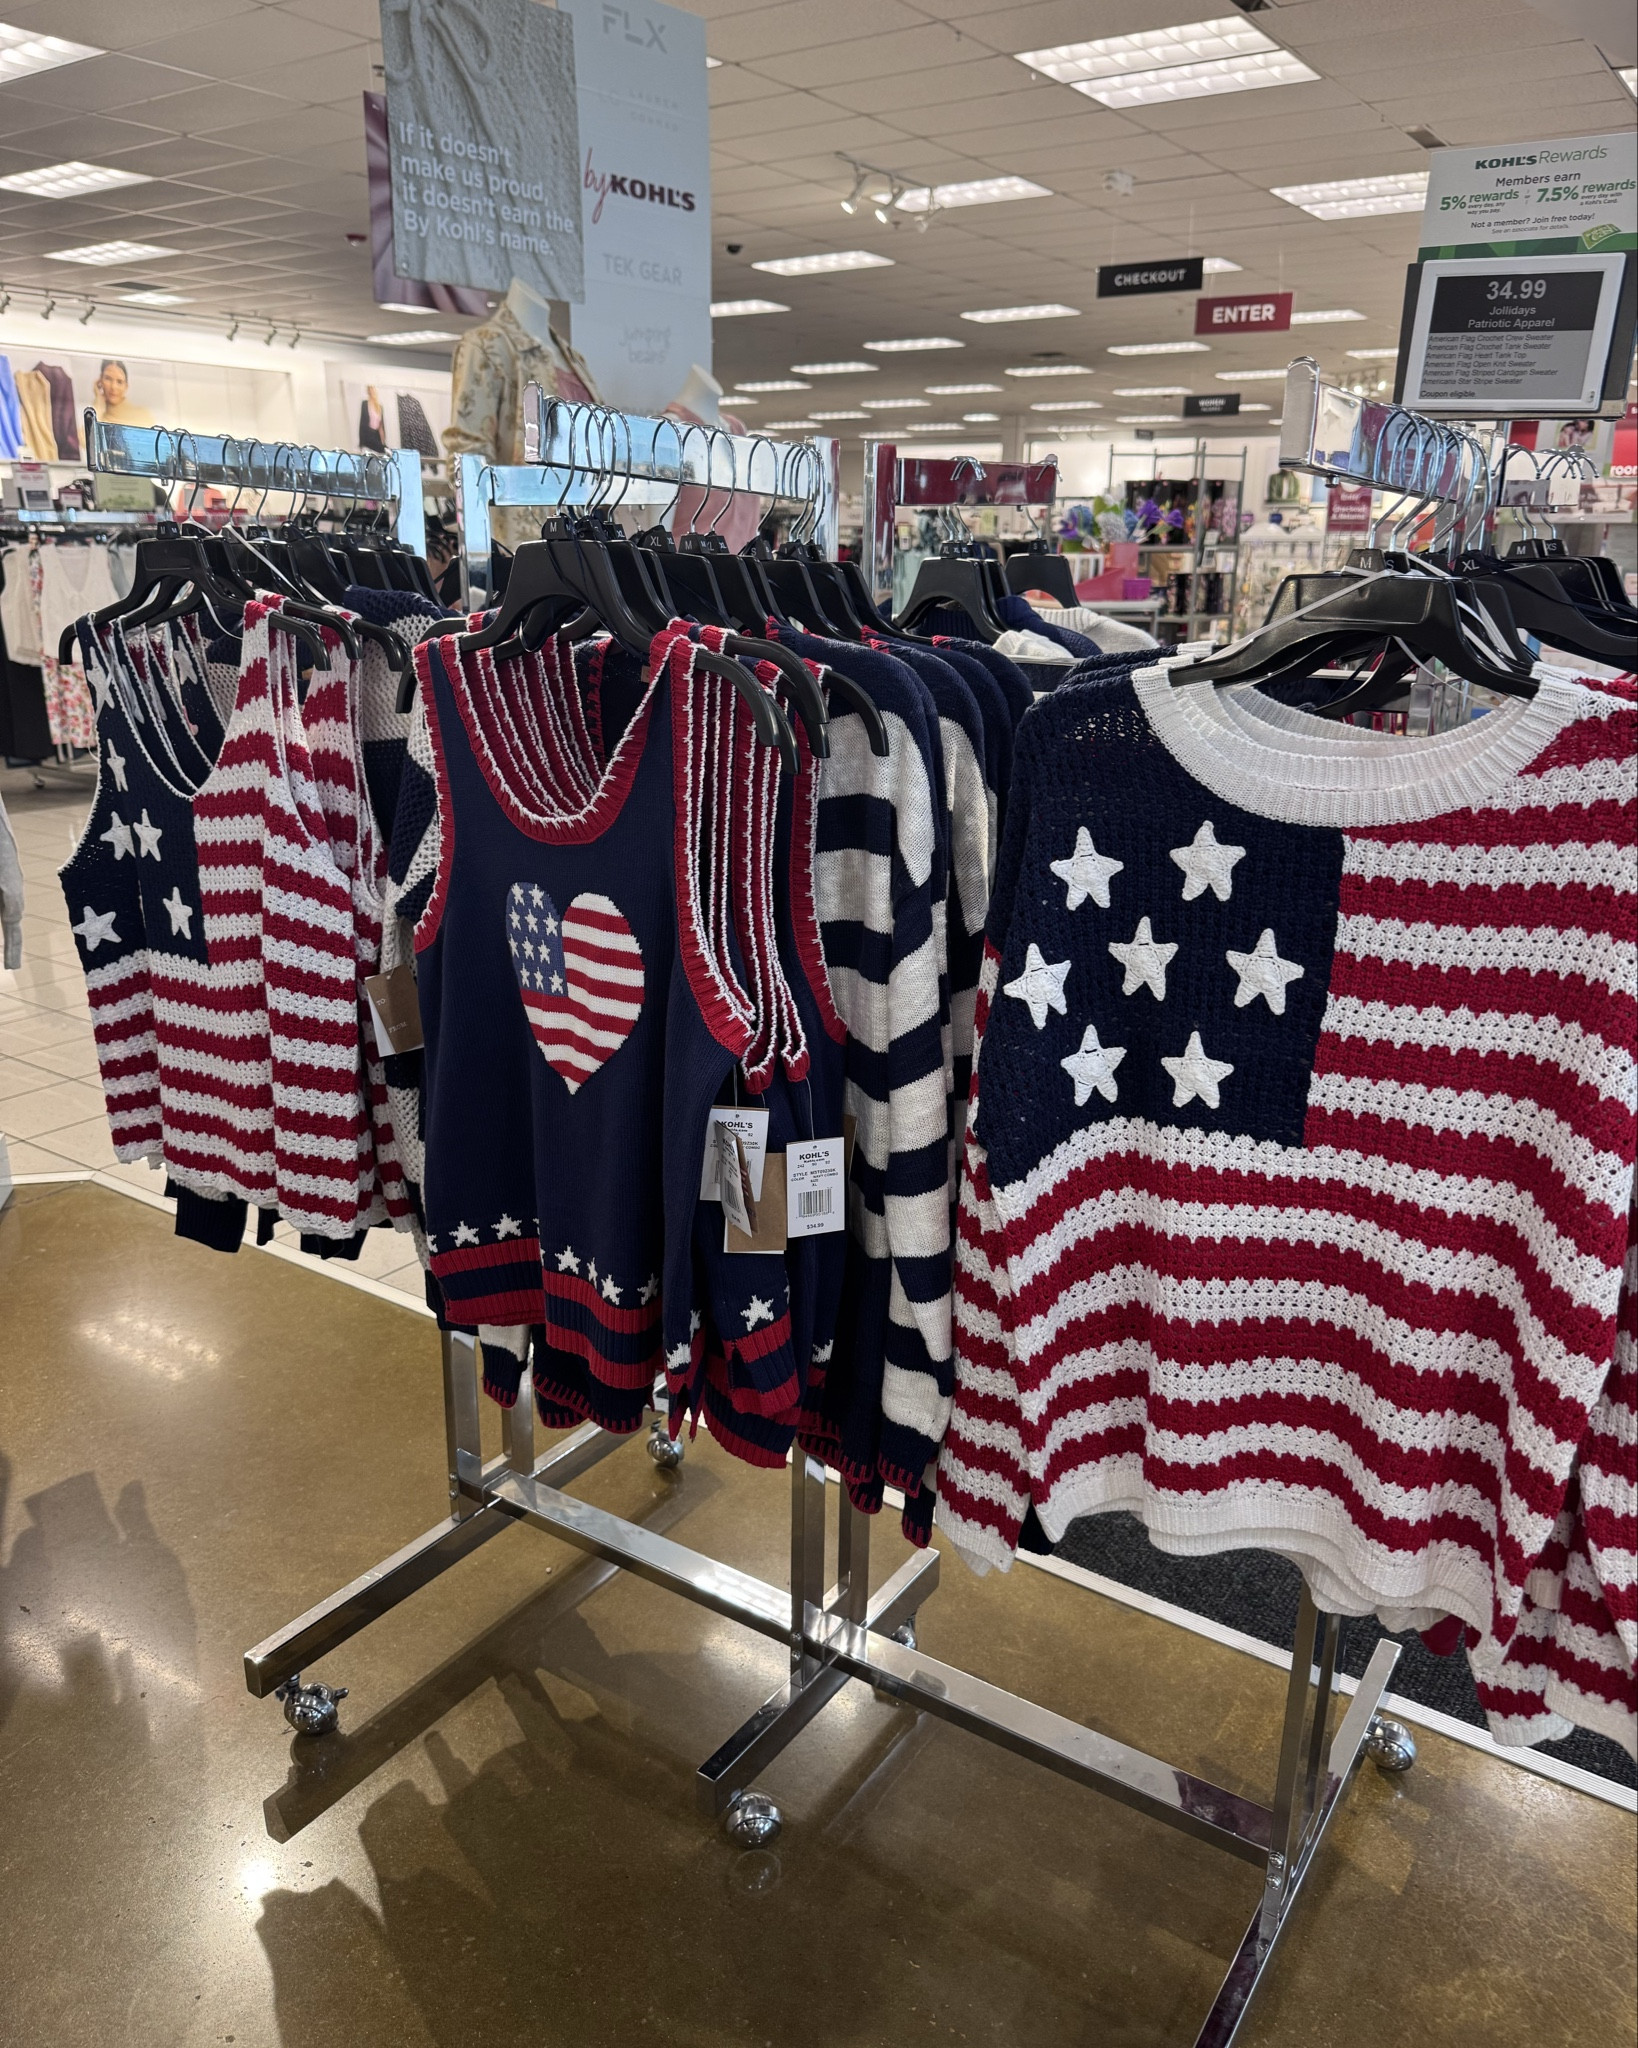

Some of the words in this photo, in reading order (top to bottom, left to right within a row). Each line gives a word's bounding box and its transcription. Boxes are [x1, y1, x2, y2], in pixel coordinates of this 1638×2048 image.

[602, 3, 668, 55] FLX
[399, 121, 414, 145] If
[419, 126, 435, 150] it
[440, 133, 512, 168] doesn't
[1475, 155, 1537, 170] KOHL'S
[1538, 145, 1608, 165] Rewards
[401, 155, 456, 183] make
[462, 168, 483, 189] us
[489, 174, 549, 207] proud,
[1495, 174, 1550, 188] Members
[1553, 171, 1581, 183] earn
[610, 173, 696, 213] KOHL'S
[1536, 185, 1579, 203] 7.5%
[1582, 178, 1637, 194] rewards
[402, 179, 417, 204] it
[423, 184, 497, 219] doesn't
[501, 204, 541, 228] earn
[546, 210, 574, 233] the
[1439, 194, 1467, 211] 5%
[1469, 188, 1519, 203] rewards
[1470, 220, 1486, 230] Not
[1493, 216, 1531, 228] member?
[1532, 215, 1550, 225] Join
[1551, 213, 1567, 223] free
[1569, 212, 1596, 223] today!
[403, 210, 429, 238] By
[436, 215, 496, 245] Kohl's
[500, 231, 554, 256] name.
[603, 252, 635, 278] TEK
[639, 260, 683, 286] GEAR
[1114, 268, 1187, 287] CHECKOUT
[1486, 279, 1547, 300] 34.99
[1211, 303, 1276, 324] ENTER
[1489, 305, 1537, 317] Jollidays
[1467, 319, 1511, 329] Patriotic
[1513, 317, 1556, 330] Apparel
[1428, 335, 1459, 343] American
[1461, 335, 1476, 343] Flag
[1477, 334, 1504, 342] Crochet
[1525, 333, 1555, 341] Sweater
[1459, 343, 1474, 352] Flag
[1475, 342, 1503, 351] Crochet
[1522, 342, 1552, 350] Sweater
[1426, 352, 1457, 360] American
[1458, 352, 1473, 360] Flag
[1474, 351, 1493, 359] Heart
[1495, 351, 1512, 359] Tank
[1513, 351, 1527, 359] Top
[1456, 360, 1471, 369] Flag
[1473, 360, 1492, 368] Open
[1493, 360, 1507, 368] Knit
[1455, 369, 1470, 378] Flag
[1471, 369, 1496, 377] Striped
[1497, 368, 1528, 377] Cardigan
[1529, 368, 1558, 376] Sweater
[1473, 377, 1493, 386] Stripe
[1494, 377, 1523, 385] Sweater
[1420, 390, 1448, 399] Coupon
[550, 521, 557, 532] M
[650, 535, 662, 547] XL
[685, 540, 693, 550] M
[1516, 545, 1526, 555] M
[1360, 556, 1372, 569] M
[1461, 559, 1480, 572] XL
[721, 1121, 753, 1129] KOHL'S
[799, 1150, 830, 1161] KOHL'S
[806, 1222, 824, 1230] $34.99
